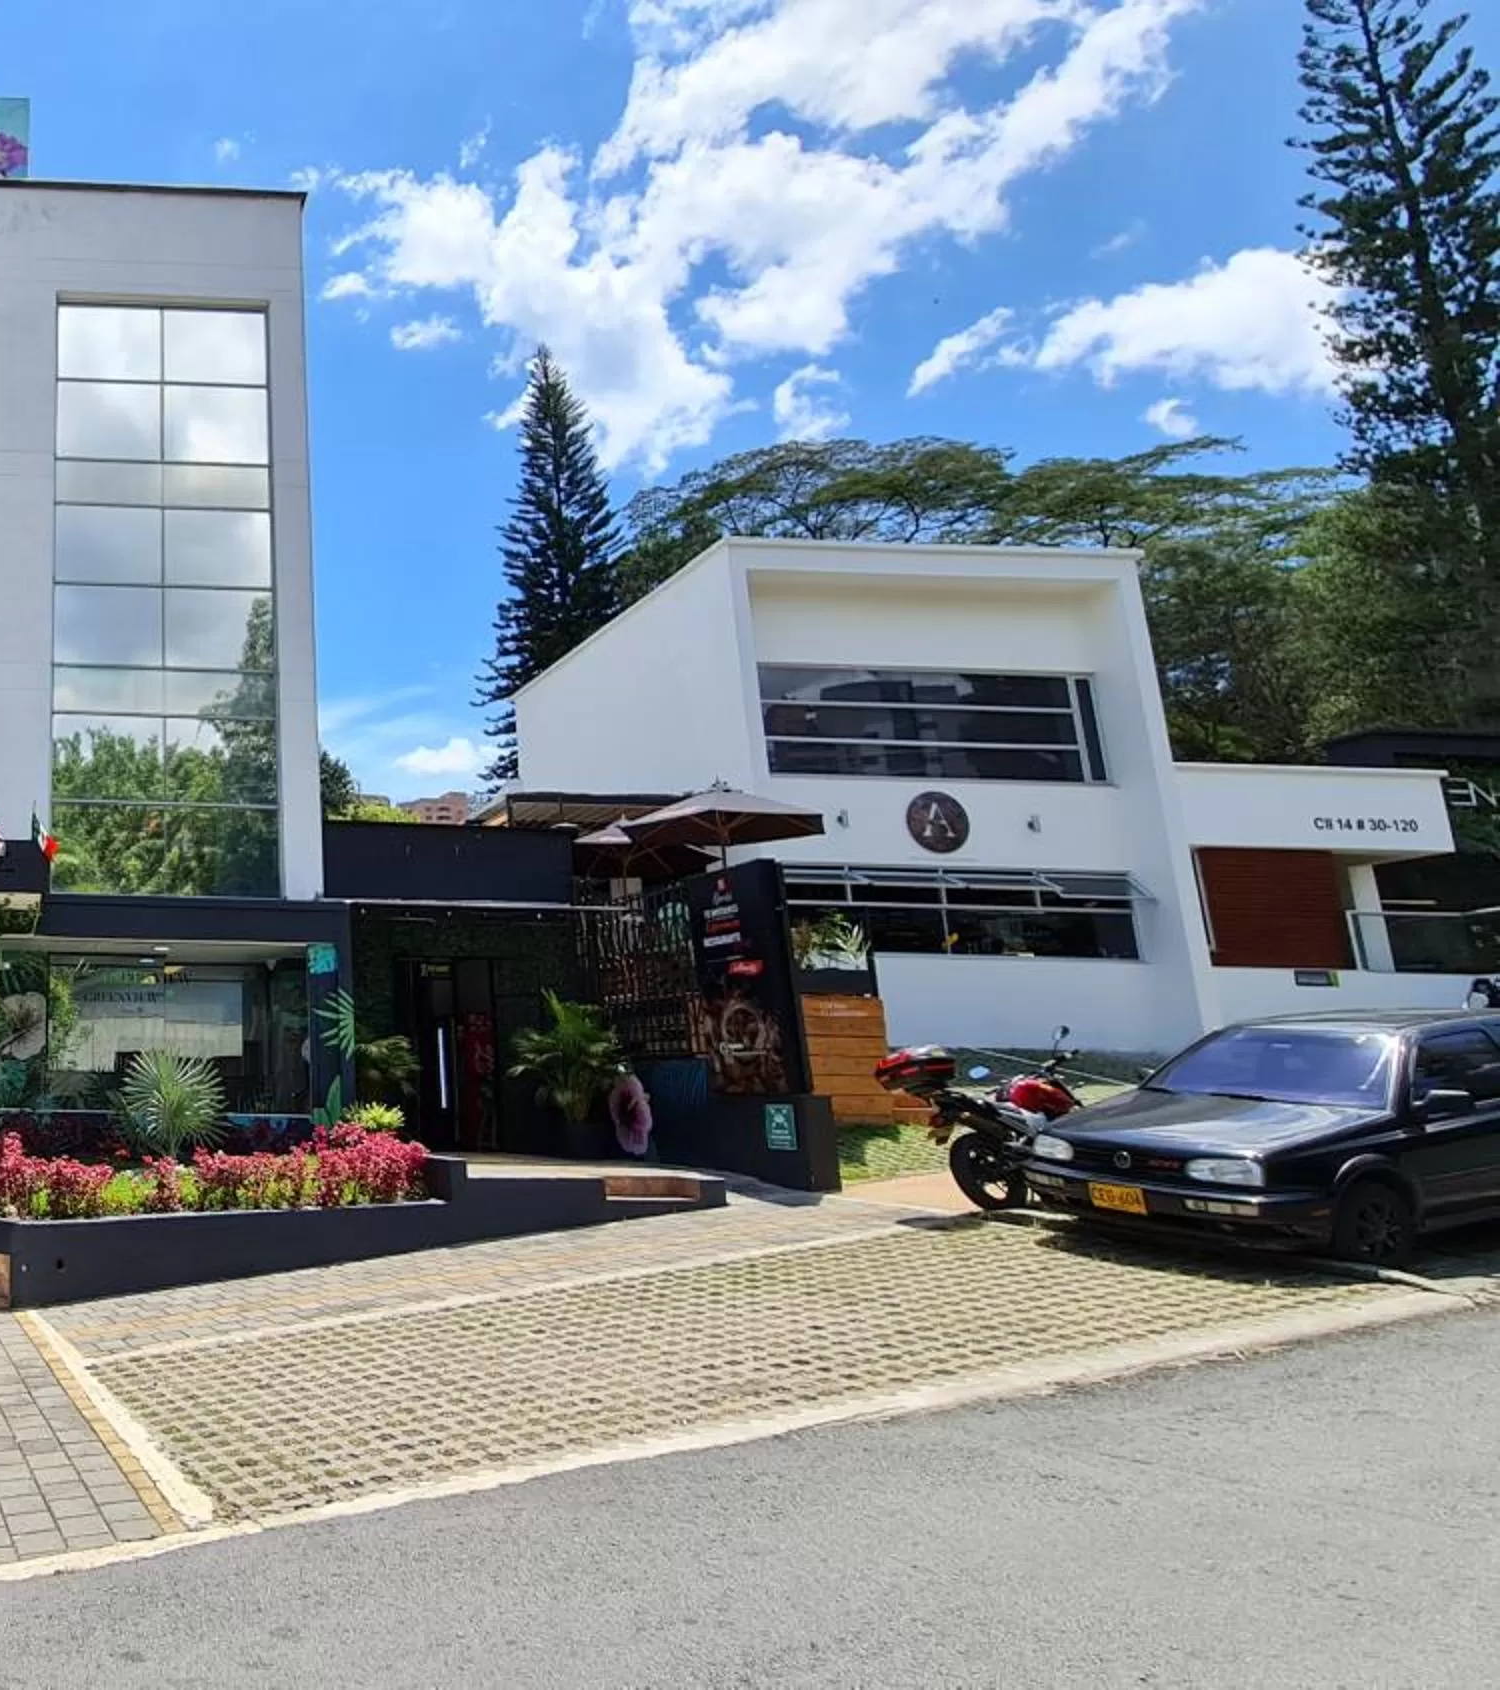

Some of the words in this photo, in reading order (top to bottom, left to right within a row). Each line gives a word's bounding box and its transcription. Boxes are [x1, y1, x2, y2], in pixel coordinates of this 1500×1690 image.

[922, 801, 956, 838] A
[1336, 817, 1353, 831] 14
[1368, 818, 1419, 833] 30-120
